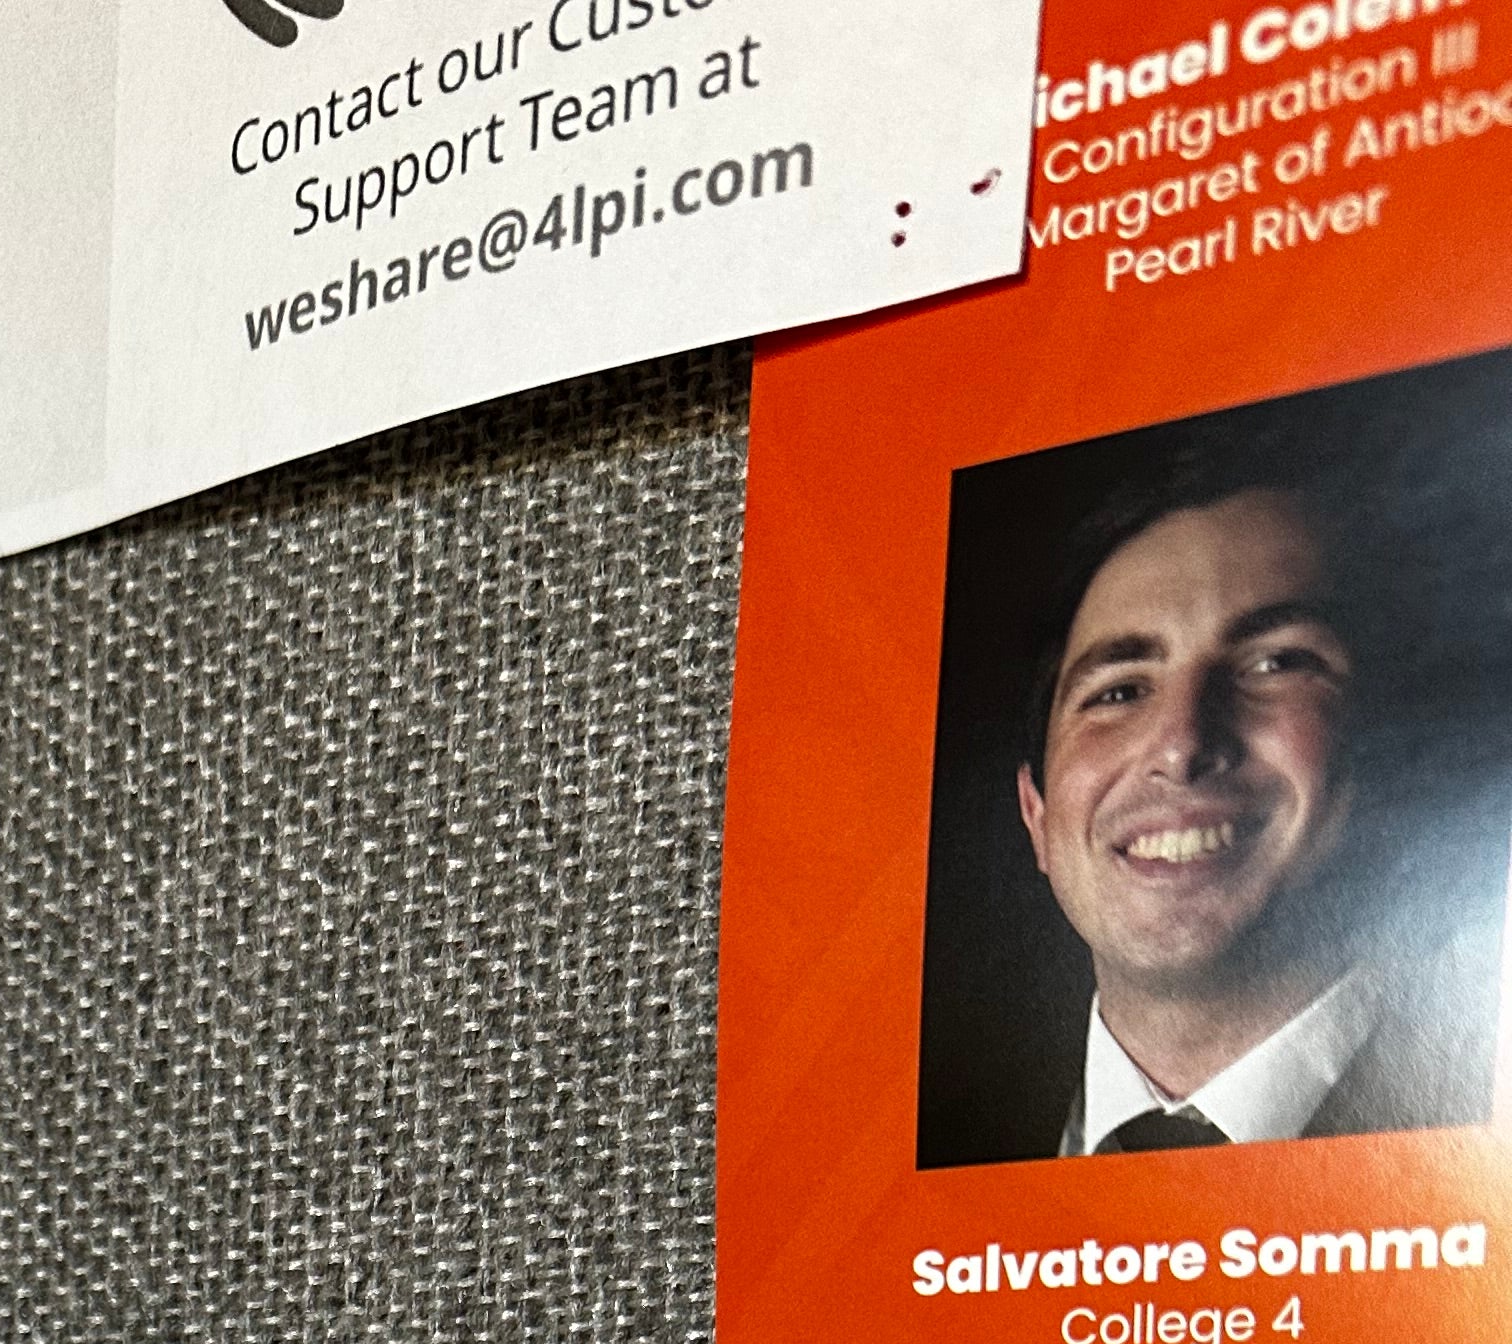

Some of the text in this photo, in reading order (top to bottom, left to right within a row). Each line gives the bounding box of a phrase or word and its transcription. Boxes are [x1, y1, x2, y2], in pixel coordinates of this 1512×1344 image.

[231, 60, 424, 177] Contact
[437, 17, 534, 96] our
[292, 33, 762, 236] Support Team at
[1043, 45, 1418, 183] Configuration
[1273, 122, 1330, 184] of
[244, 140, 815, 350] weshare@4lpi.com
[1105, 184, 1390, 292] Pearl River
[912, 1221, 1487, 1296] Salvatore Somma
[1271, 1295, 1305, 1340] 4
